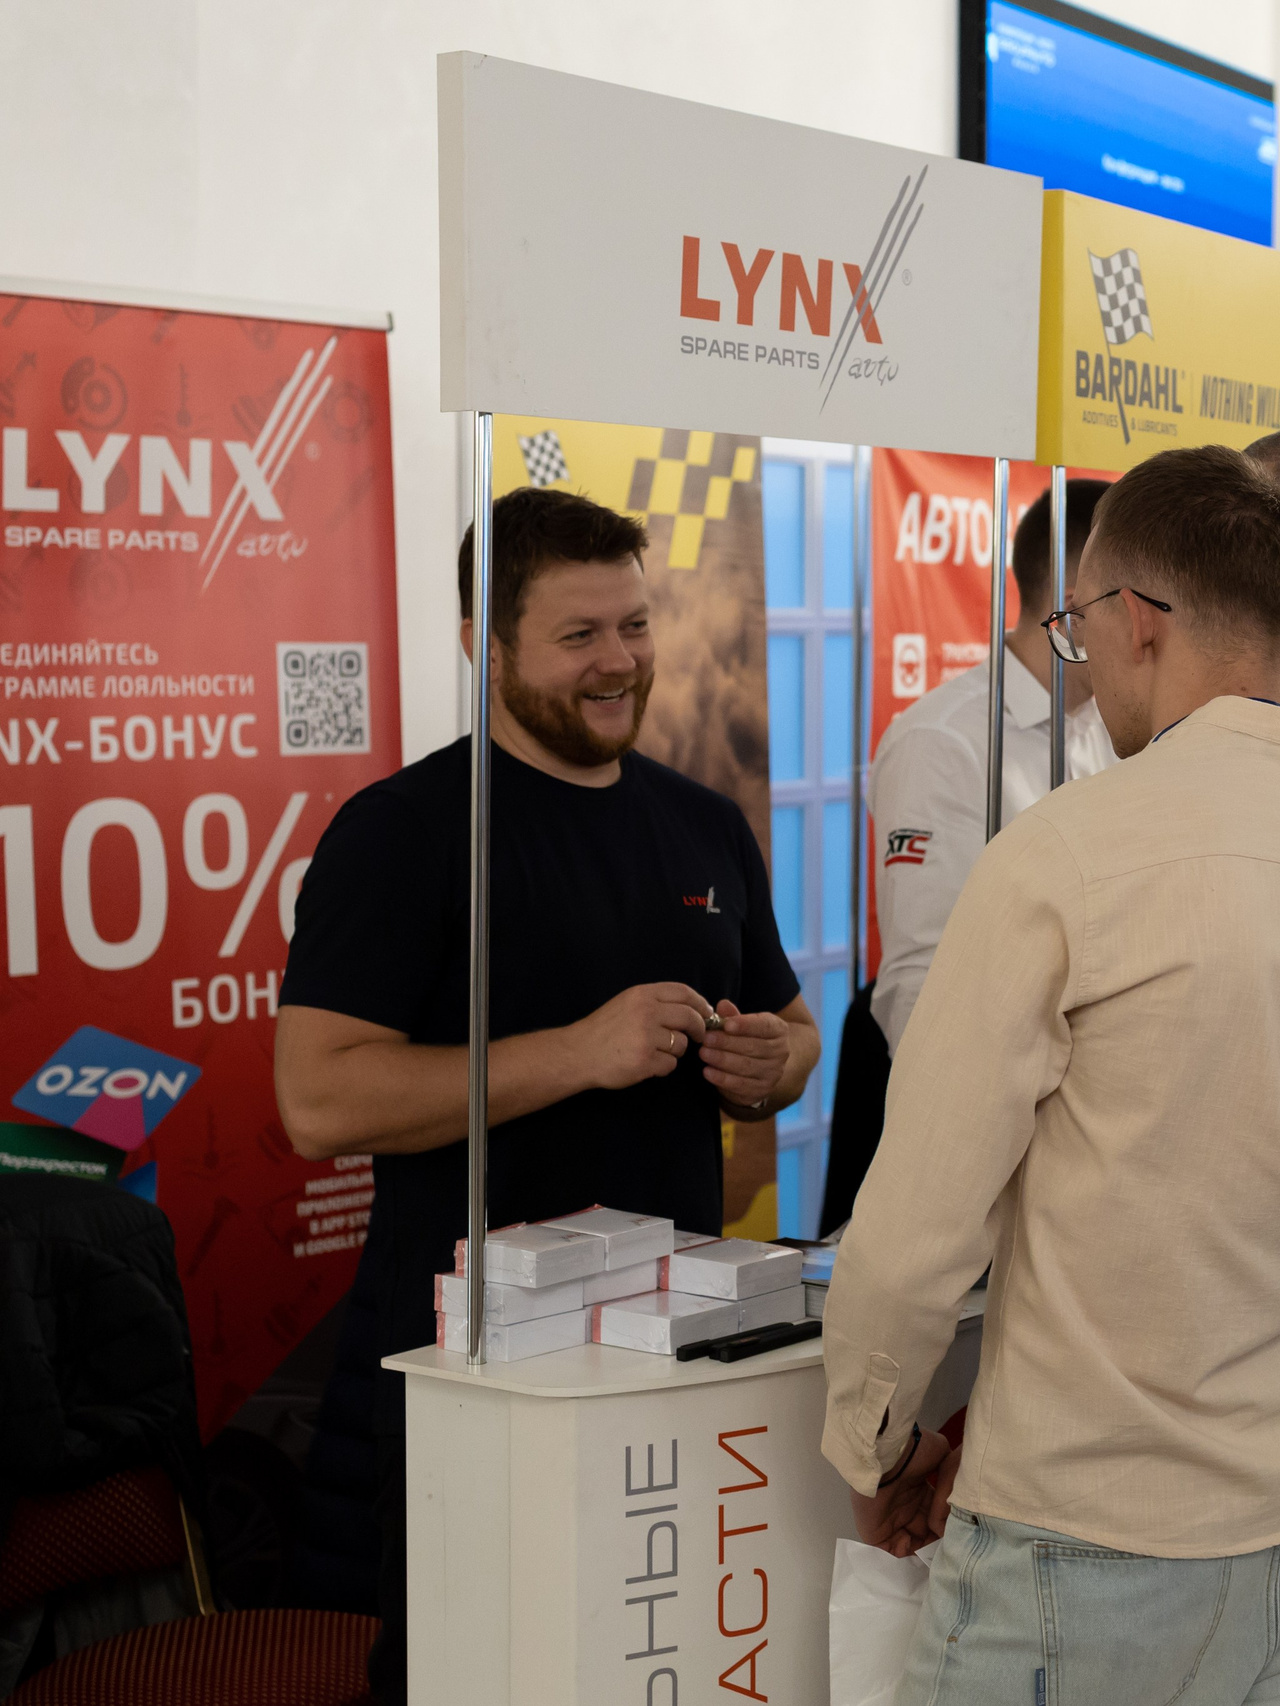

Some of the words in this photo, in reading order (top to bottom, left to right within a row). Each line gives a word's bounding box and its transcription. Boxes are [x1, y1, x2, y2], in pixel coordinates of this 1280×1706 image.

[680, 228, 892, 346] LYNX
[680, 335, 749, 361] SPARE
[755, 345, 820, 370] PARTS
[1075, 350, 1184, 415] BARDAHL
[3, 424, 288, 522] LYNX
[4, 526, 101, 549] SPARE
[108, 529, 200, 552] PARTS
[895, 492, 1028, 568] АВТО
[0, 638, 159, 670] ЕДИНЯЙТЕСЬ
[102, 674, 255, 698] ЛОЯЛЬНОСТИ
[172, 970, 287, 1028] БОН
[36, 1064, 188, 1101] OZON
[718, 1425, 768, 1704] АСТИ
